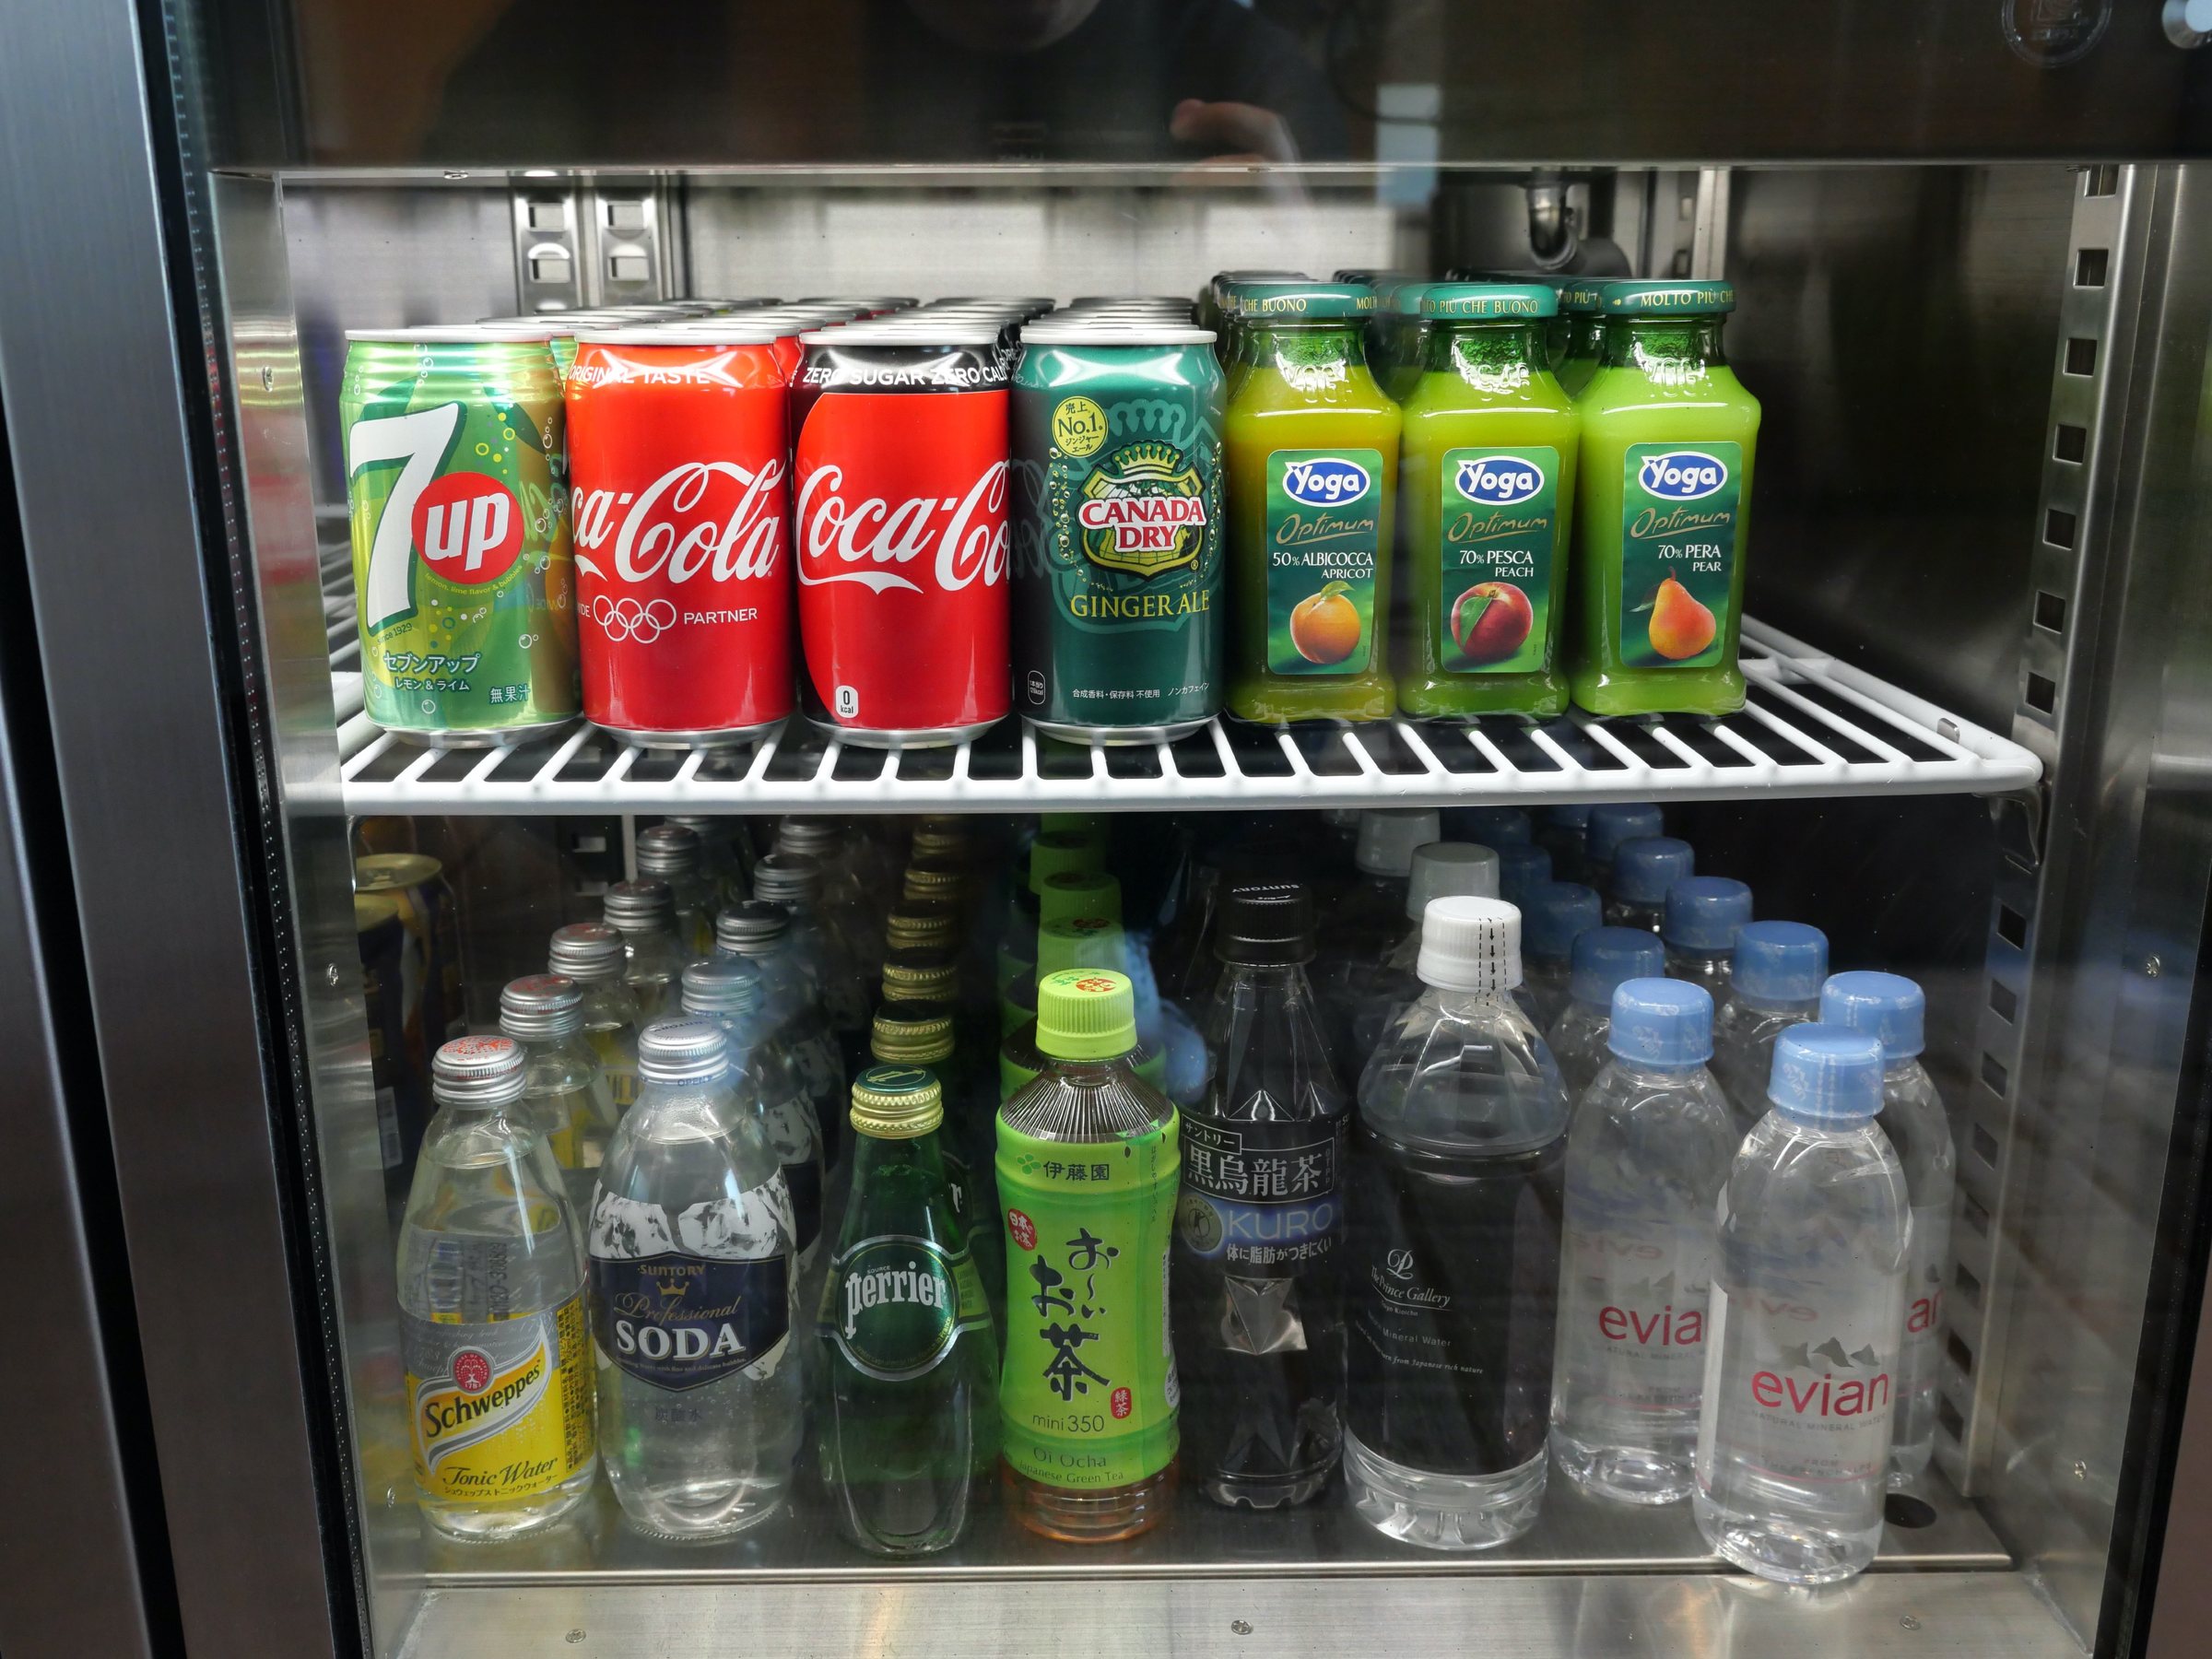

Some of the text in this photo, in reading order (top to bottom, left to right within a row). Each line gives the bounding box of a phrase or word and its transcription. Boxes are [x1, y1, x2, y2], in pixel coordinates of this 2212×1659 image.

[1262, 298, 1307, 312] BUONO
[1462, 300, 1487, 313] CHE
[1494, 300, 1538, 314] BUONO
[1641, 291, 1692, 308] MOLTO
[644, 369, 711, 385] TASTE
[849, 369, 922, 386] SUGAR
[1284, 462, 1360, 500] Yoga
[1456, 460, 1534, 499] Yoga
[1641, 455, 1717, 494] Yoga
[349, 400, 512, 636] 7 up
[1081, 500, 1206, 526] CANADA
[1630, 505, 1731, 539] Optimum
[795, 460, 1011, 595] Coca-Co
[1118, 524, 1177, 549] DRY
[1276, 512, 1374, 546] Optimum
[1447, 511, 1547, 543] Optimum
[1272, 552, 1374, 567] 50% ALBICOCCA
[1459, 549, 1535, 565] 70% PESCA
[1658, 544, 1722, 559] 70% PERA
[1321, 568, 1374, 579] APRICOT
[1495, 567, 1535, 578] PEACH
[1692, 561, 1722, 572] PEAR
[1070, 589, 1210, 618] GINGER ALE
[683, 607, 759, 626] PARTNER
[394, 622, 413, 638] 1929
[383, 651, 482, 674] セブンアップ
[394, 677, 422, 690] レモン
[437, 679, 471, 691] ライム
[489, 685, 531, 704] 無果汁
[840, 704, 854, 713] kcal
[841, 690, 851, 706] 0
[1185, 1122, 1236, 1146] サントリー
[1042, 1160, 1111, 1182] 伊藤園
[1228, 1203, 1334, 1240] KURO
[1226, 1237, 1332, 1265] 体に脂肪がつきにくい
[1379, 1277, 1406, 1300] Prince
[1406, 1286, 1452, 1310] Gallery
[613, 1292, 742, 1326] Professional
[1382, 1326, 1418, 1344] Mineral
[1421, 1335, 1452, 1347] Water
[1599, 1303, 1705, 1348] evia
[616, 1319, 747, 1361] SODA
[1460, 1364, 1484, 1375] nature
[425, 1363, 540, 1439] Schweppes
[1751, 1369, 1889, 1418] evian
[1806, 1422, 1855, 1432] MINERAL
[442, 1457, 559, 1487] Tonic Water
[1060, 1454, 1107, 1469] Ocha
[1066, 1473, 1101, 1484] Green
[1104, 1471, 1124, 1481] Tea
